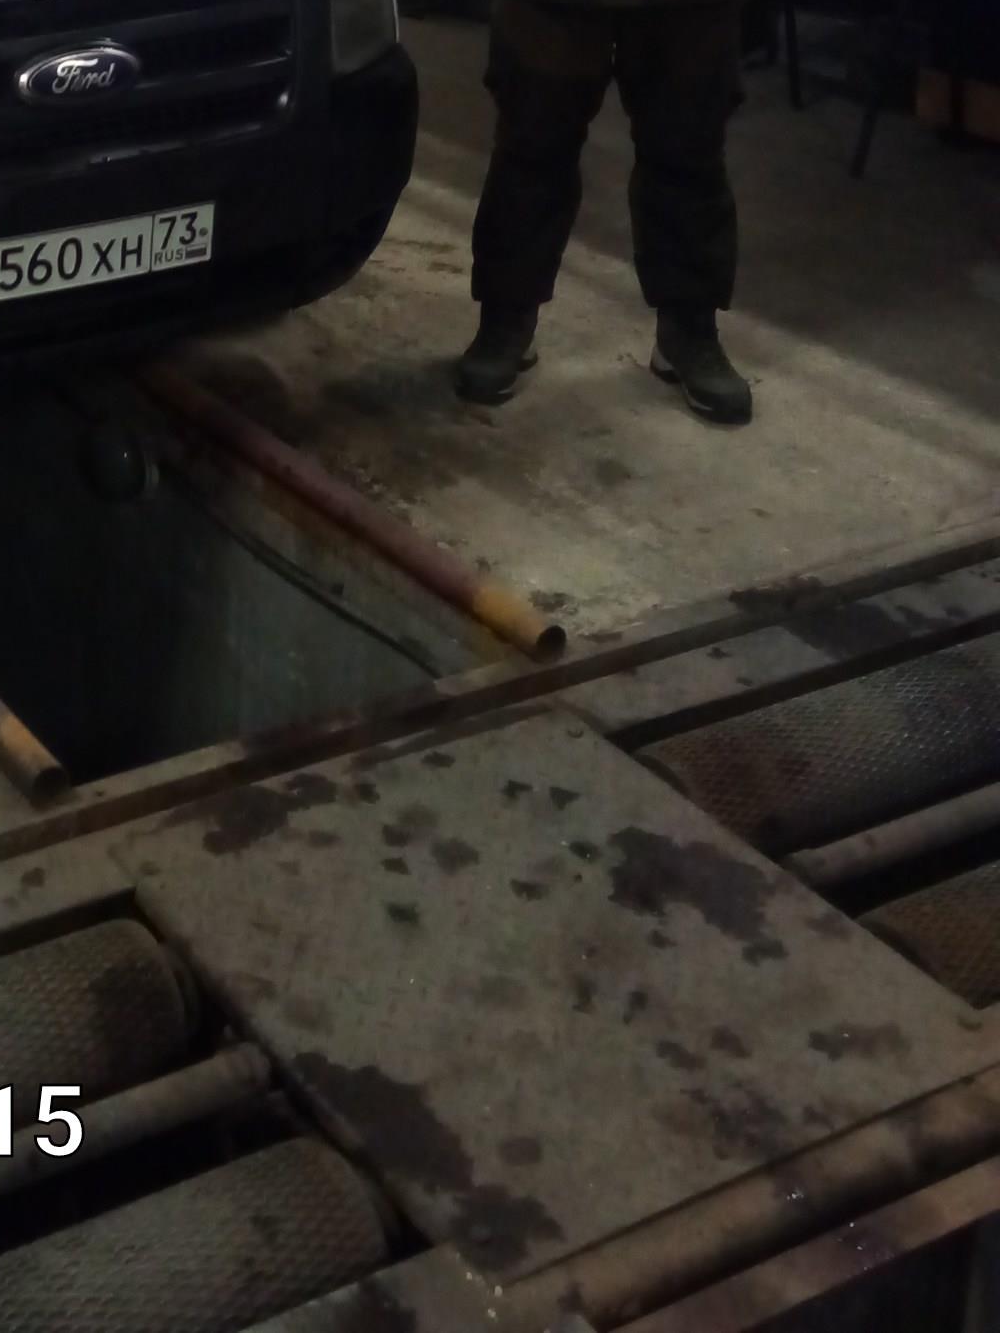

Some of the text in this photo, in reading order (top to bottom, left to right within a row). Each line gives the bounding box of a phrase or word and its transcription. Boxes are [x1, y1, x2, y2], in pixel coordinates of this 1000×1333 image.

[52, 58, 115, 94] Ford
[158, 211, 198, 250] 73
[154, 250, 184, 266] RUS
